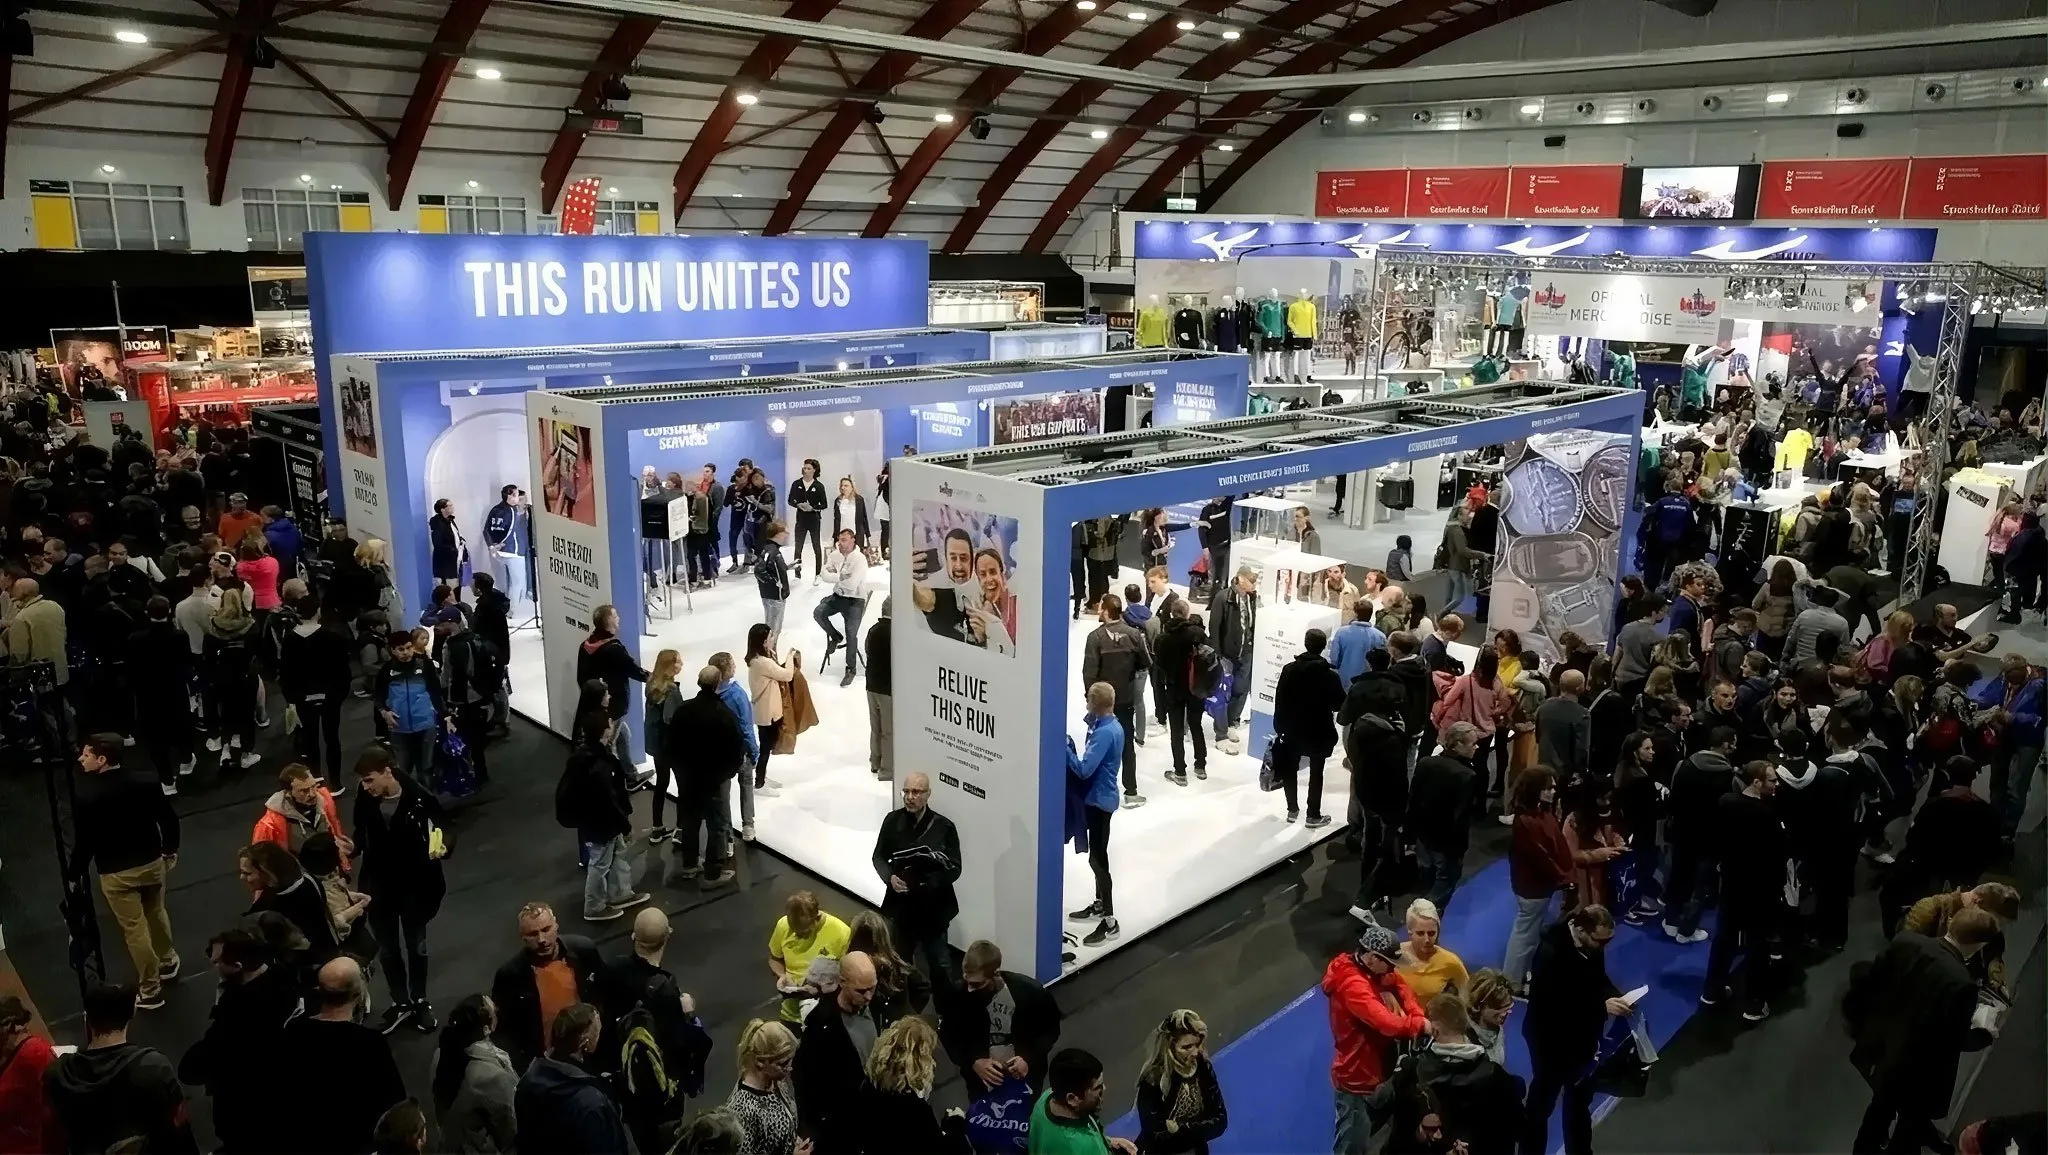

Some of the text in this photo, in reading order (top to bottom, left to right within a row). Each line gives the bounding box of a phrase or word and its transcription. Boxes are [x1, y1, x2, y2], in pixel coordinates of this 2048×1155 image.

[464, 261, 851, 317] THIS RUN UNITES US
[938, 665, 988, 704] RELIVE
[930, 694, 995, 739] THIS RUN
